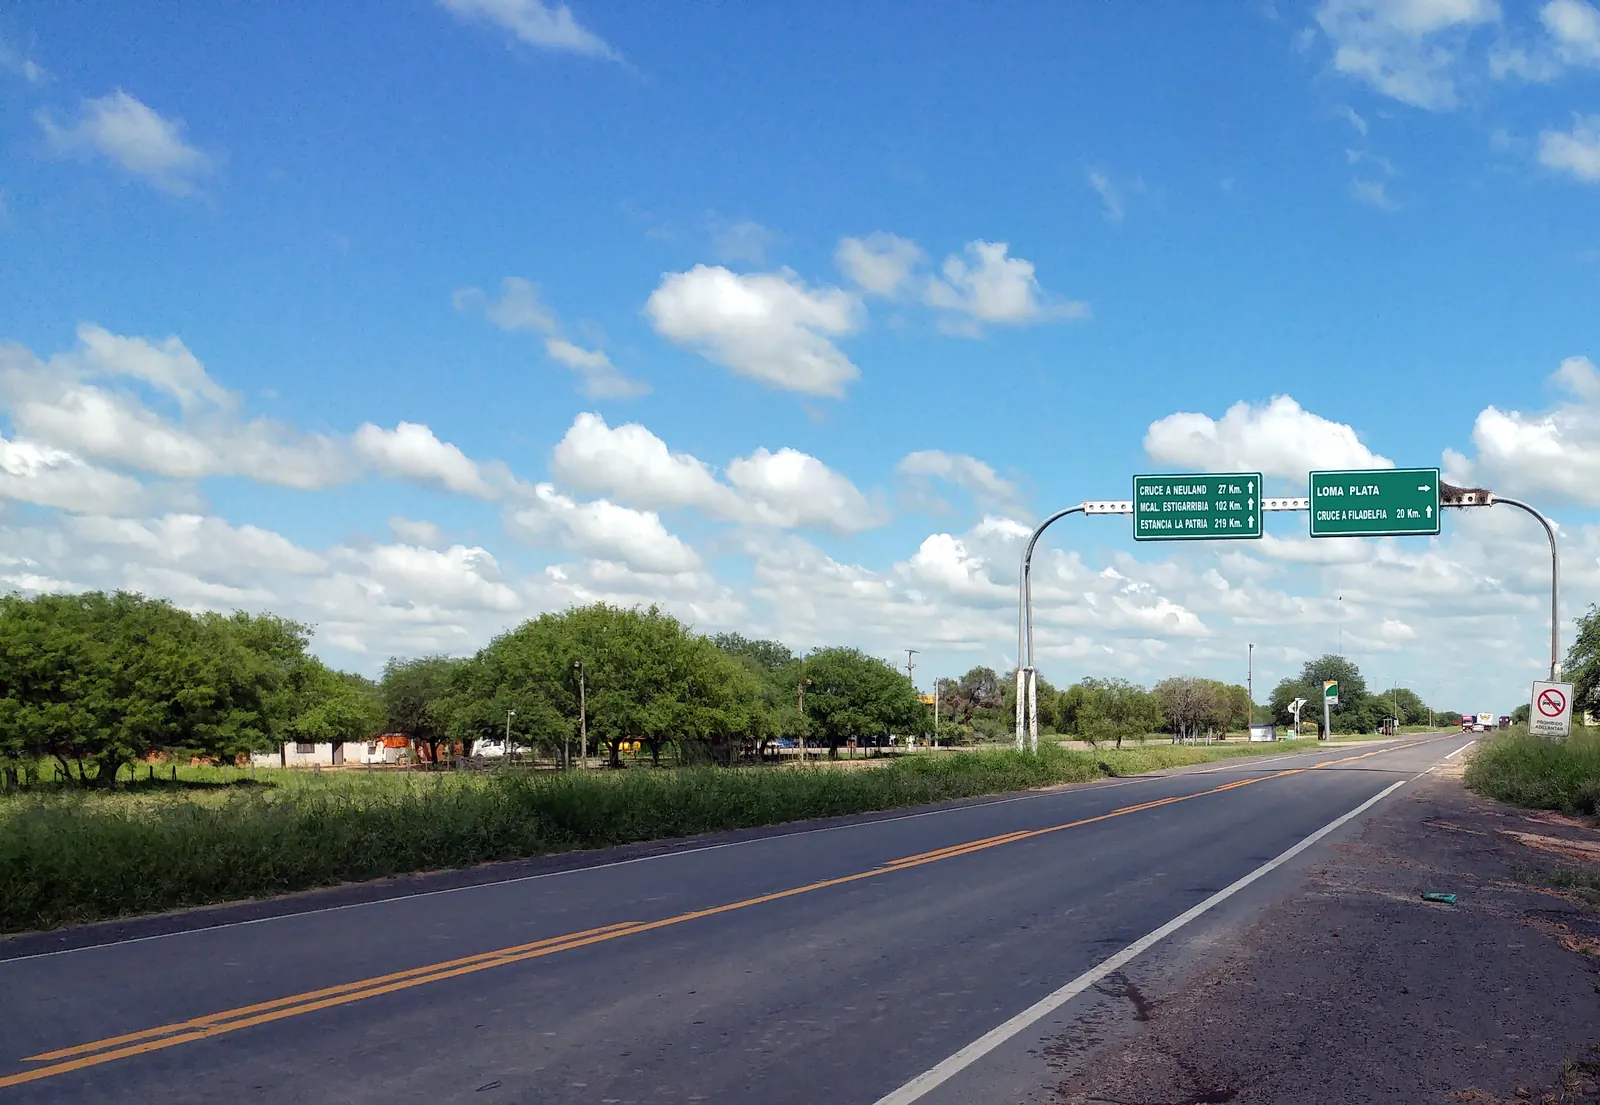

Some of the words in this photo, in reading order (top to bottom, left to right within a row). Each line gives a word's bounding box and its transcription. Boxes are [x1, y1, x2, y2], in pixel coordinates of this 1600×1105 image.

[1140, 486, 1163, 495] CRUCE
[1166, 486, 1171, 495] A
[1174, 485, 1206, 495] NEULAND
[1218, 485, 1226, 494] 27
[1229, 485, 1242, 494] Km.
[1317, 487, 1344, 496] LOMA
[1350, 486, 1379, 495] PLATA
[1140, 502, 1160, 512] MCAL.
[1163, 502, 1208, 511] ESTIGARRIBIA
[1215, 501, 1227, 510] 102
[1229, 501, 1242, 510] Km.
[1317, 510, 1339, 520] CRUCE
[1342, 510, 1346, 520] A
[1348, 509, 1387, 520] FILADELFIA
[1396, 509, 1404, 518] 20
[1407, 509, 1420, 518] Km.
[1141, 519, 1172, 529] ESTANCIA
[1175, 519, 1183, 528] LA
[1185, 519, 1208, 528] PATRIA
[1215, 519, 1226, 528] 219
[1229, 519, 1242, 528] Km.
